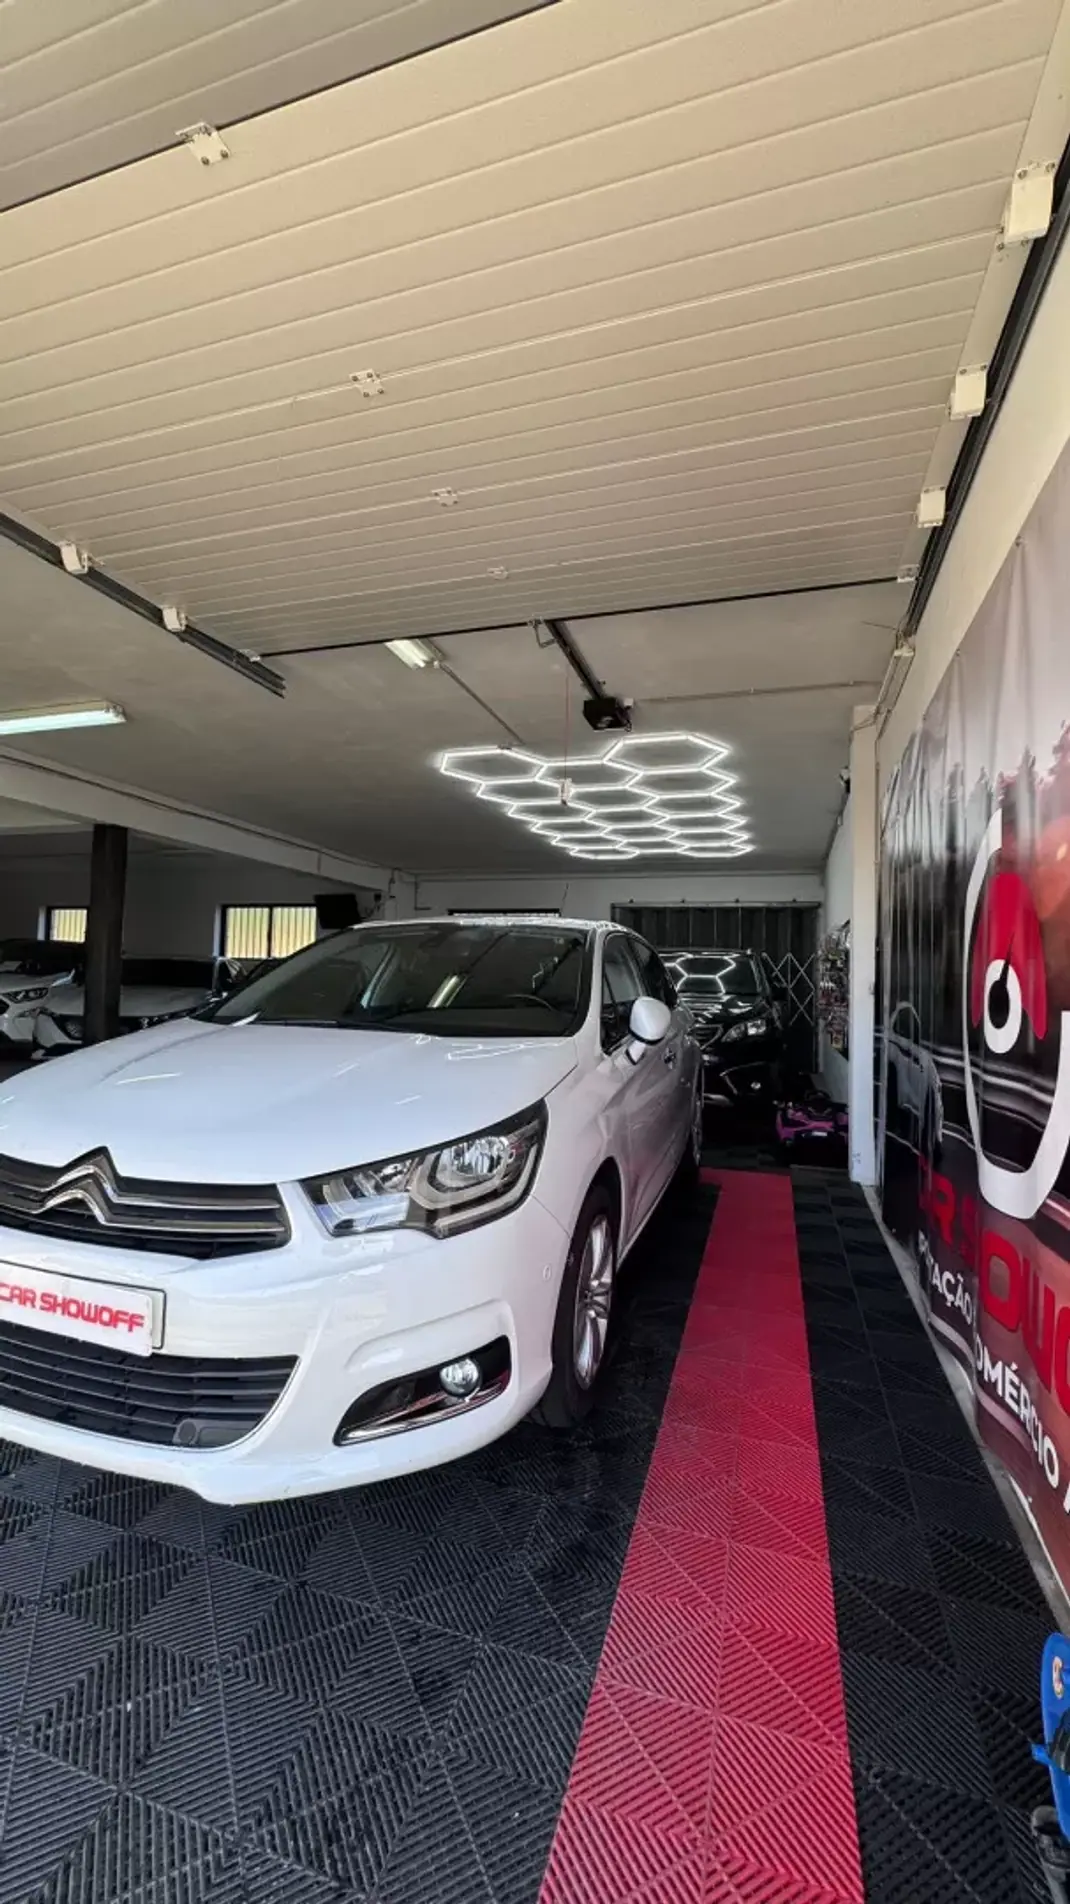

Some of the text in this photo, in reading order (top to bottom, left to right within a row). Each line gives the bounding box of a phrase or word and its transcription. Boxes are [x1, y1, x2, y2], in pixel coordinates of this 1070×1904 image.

[0, 1282, 145, 1332] CAR SHOWOFF
[974, 1333, 1059, 1489] OMÉRCIO
